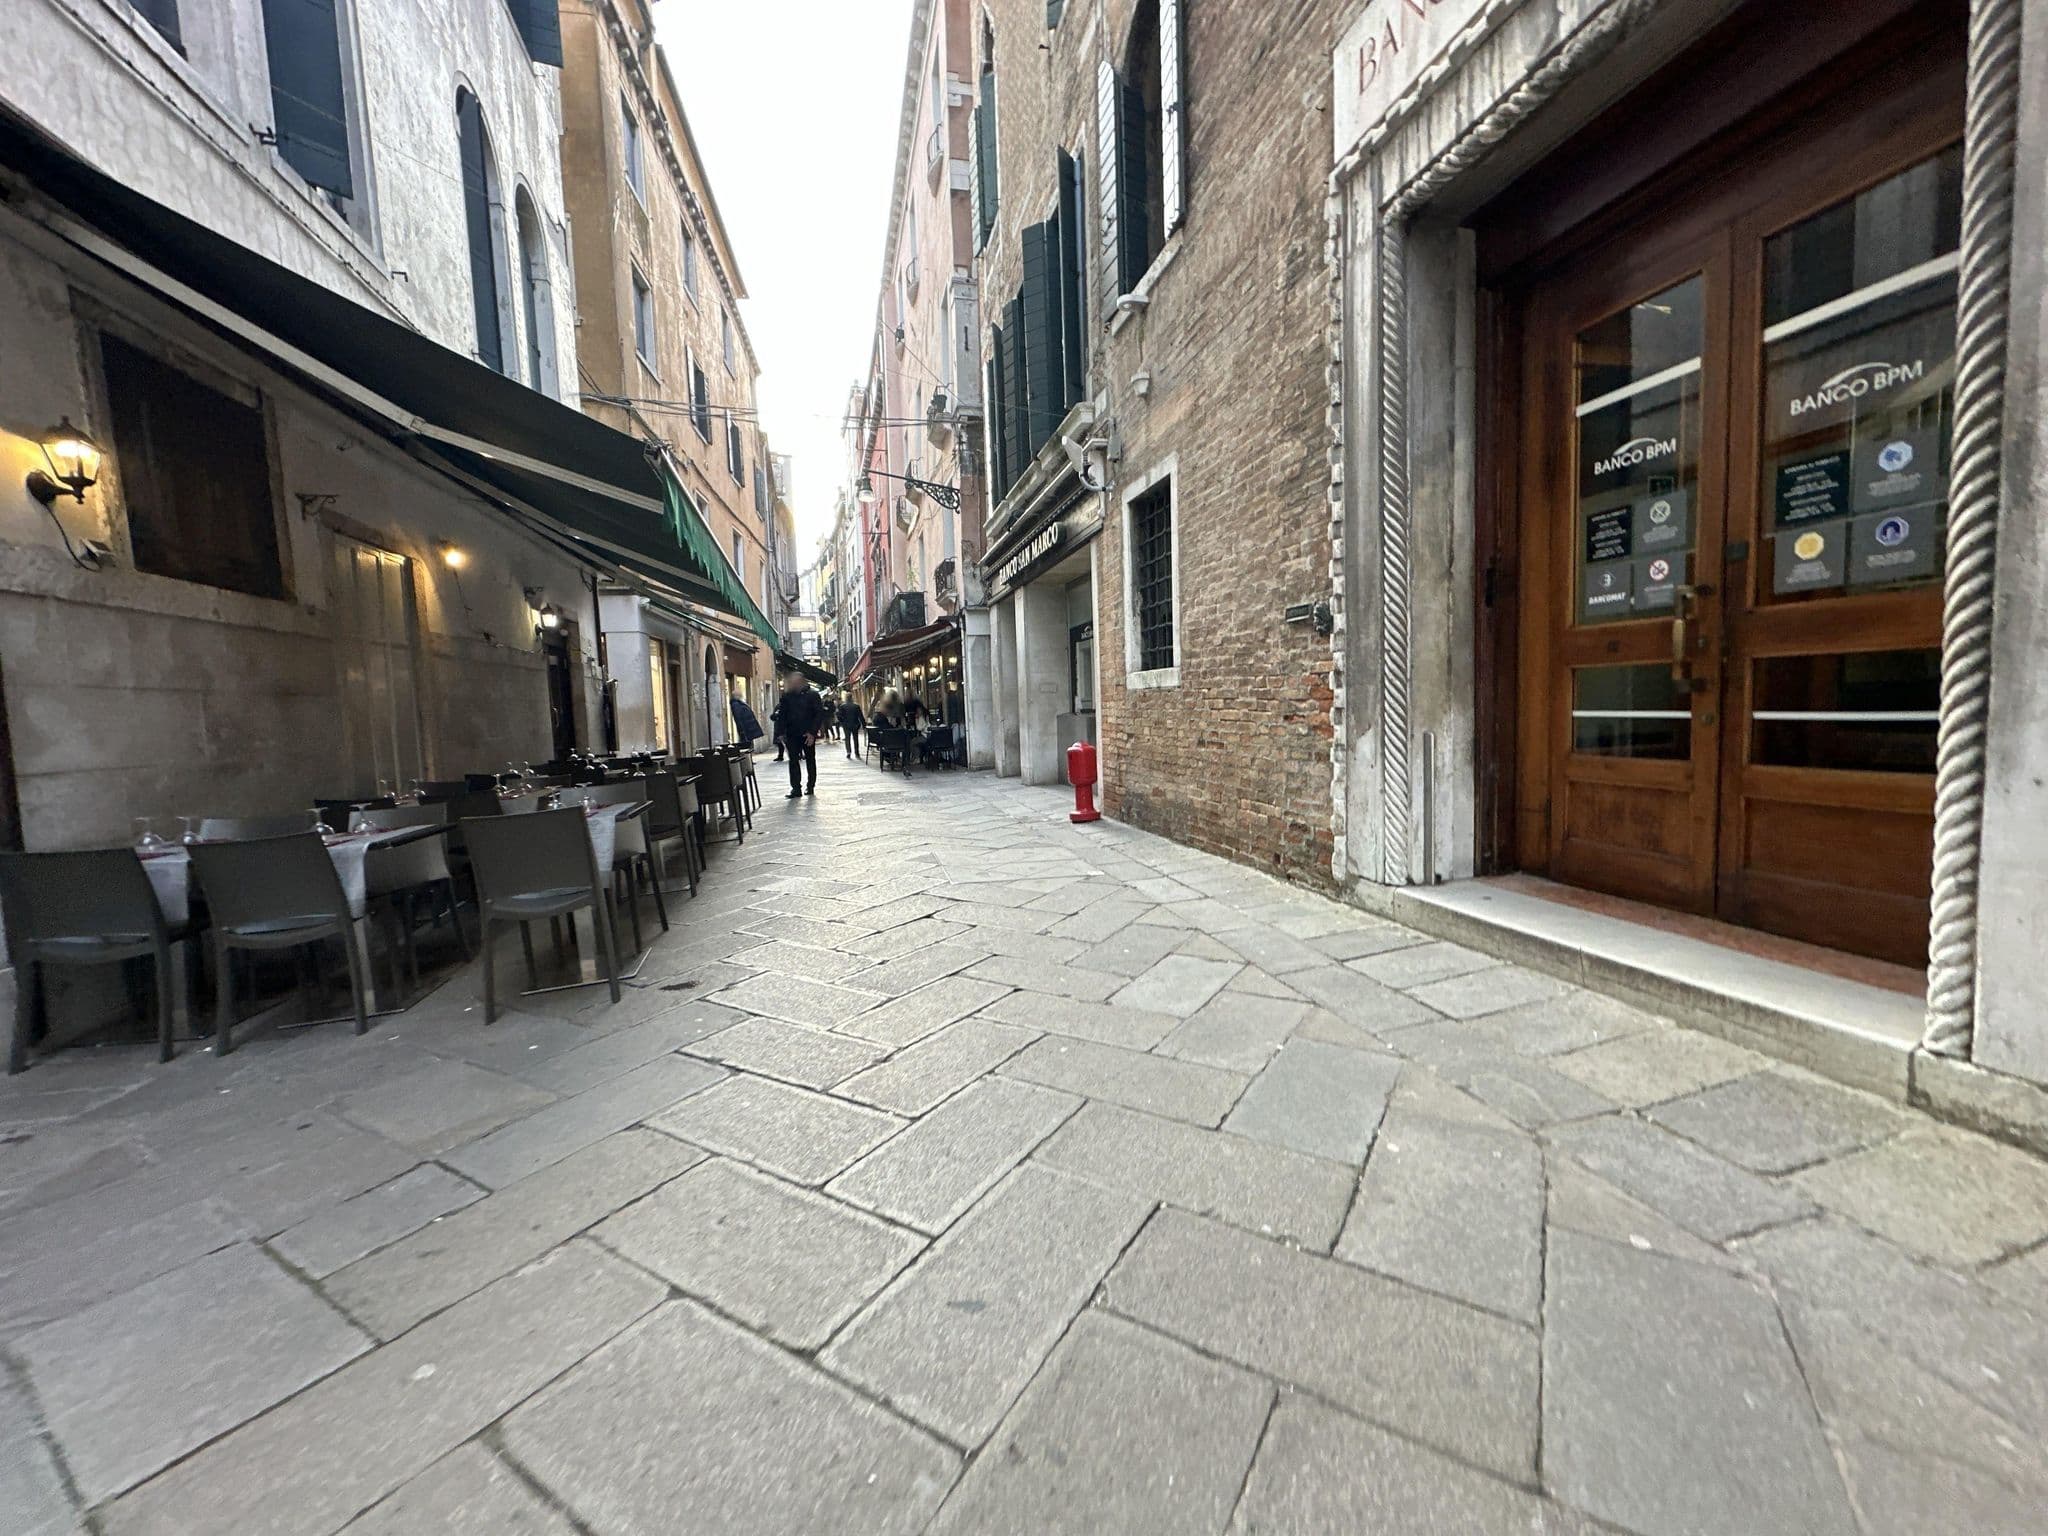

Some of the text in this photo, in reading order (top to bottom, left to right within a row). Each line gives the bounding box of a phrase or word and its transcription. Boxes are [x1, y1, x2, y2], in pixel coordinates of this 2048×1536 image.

[1790, 360, 1923, 416] BANCO BPM
[1594, 437, 1677, 475] BANCO BPM
[999, 522, 1058, 586] BANCO SAN MARCO
